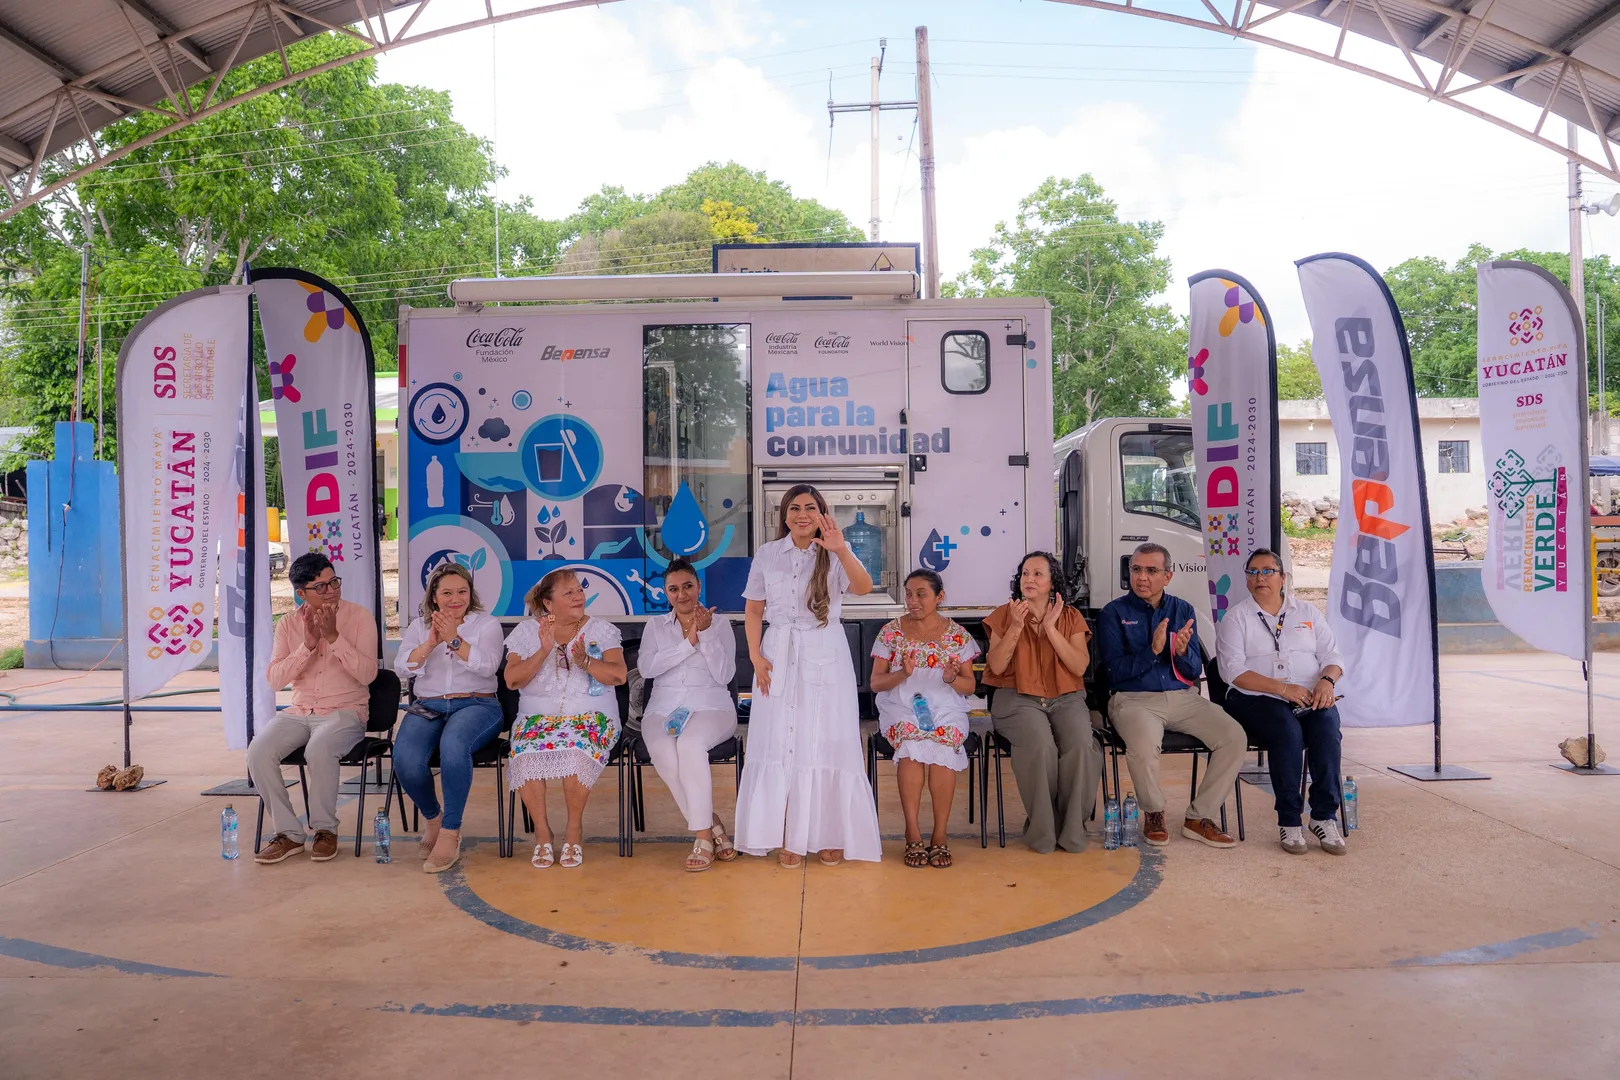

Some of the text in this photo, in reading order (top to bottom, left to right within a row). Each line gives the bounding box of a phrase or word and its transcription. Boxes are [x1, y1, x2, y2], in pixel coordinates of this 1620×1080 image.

[183, 333, 192, 345] DE
[466, 327, 526, 348] Coca-Cola
[475, 349, 514, 357] Fundación
[540, 345, 610, 363] Bepensa
[154, 346, 176, 399] SDS
[195, 342, 204, 400] DESARROLLO
[206, 340, 216, 400] SUSTENTABLE
[766, 372, 848, 403] Agua
[1483, 353, 1568, 379] YUCATÁN
[766, 400, 875, 432] para la
[1516, 393, 1543, 408] SDS
[302, 408, 340, 517] DIF
[766, 427, 950, 457] comunidad
[1207, 402, 1239, 508] DIF
[203, 461, 211, 483] 2024
[1335, 317, 1411, 639] Bepensa
[151, 431, 162, 593] RENACIMIENTO MAYA
[167, 431, 196, 593] YUCATÁN
[202, 527, 210, 544] DEL
[348, 493, 363, 561] YUCATÁN
[1558, 474, 1567, 586] YUCATÁN
[199, 545, 208, 589] GOBIERNO
[1523, 494, 1535, 592] RENACIMIENTO
[1534, 494, 1556, 592] VERDE
